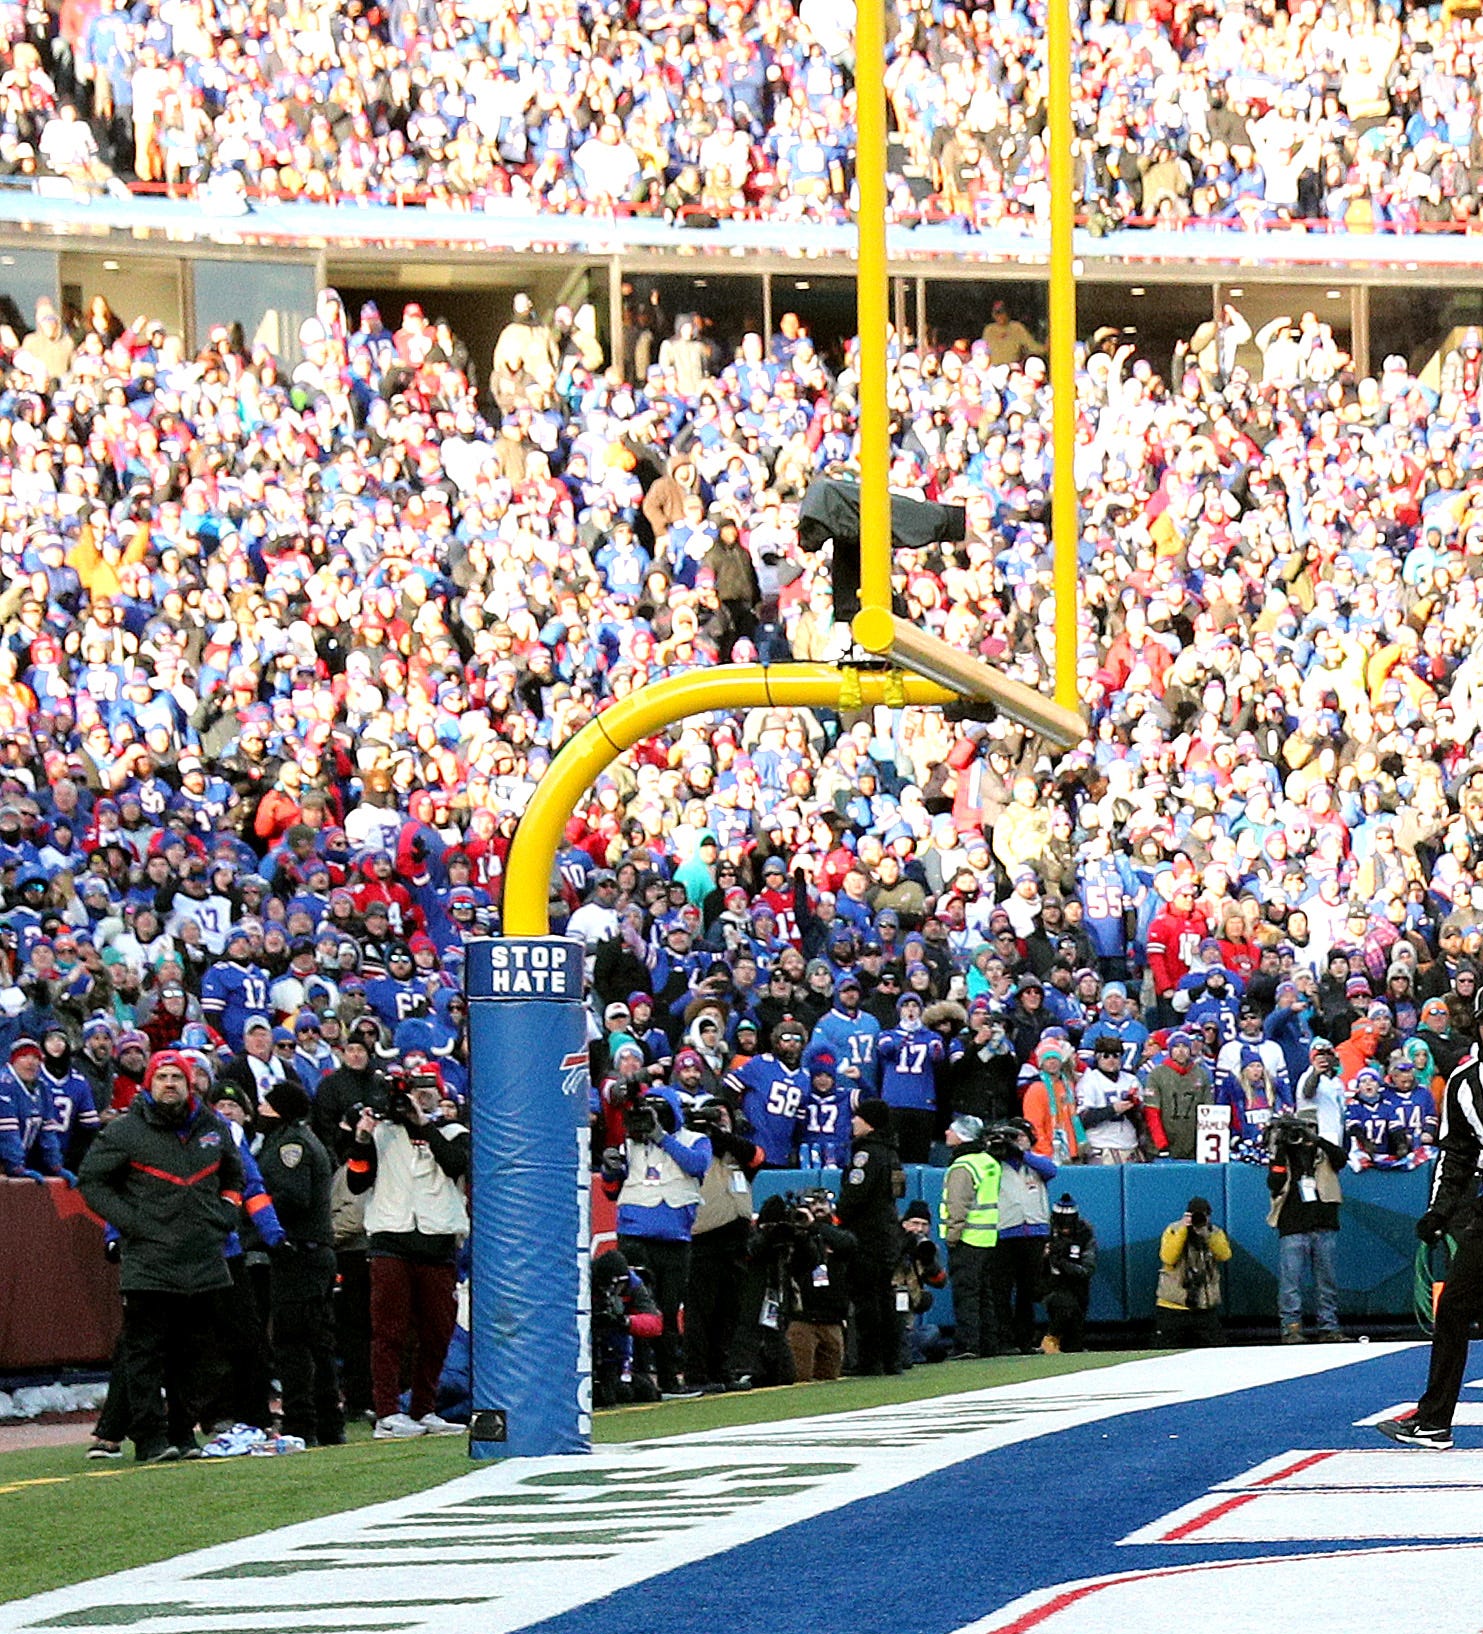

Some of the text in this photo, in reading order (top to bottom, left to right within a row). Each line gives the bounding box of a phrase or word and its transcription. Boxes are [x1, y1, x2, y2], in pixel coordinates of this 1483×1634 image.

[1085, 885, 1124, 919] 55
[491, 945, 568, 970] STOP
[242, 977, 266, 1010] 17
[491, 969, 566, 994] HATE
[848, 1033, 875, 1064] 17
[895, 1042, 928, 1074] 17
[766, 1080, 801, 1119] 58
[1171, 1091, 1196, 1120] 17
[806, 1103, 839, 1134] 17
[1363, 1119, 1388, 1145] 17
[1205, 1134, 1221, 1163] 3
